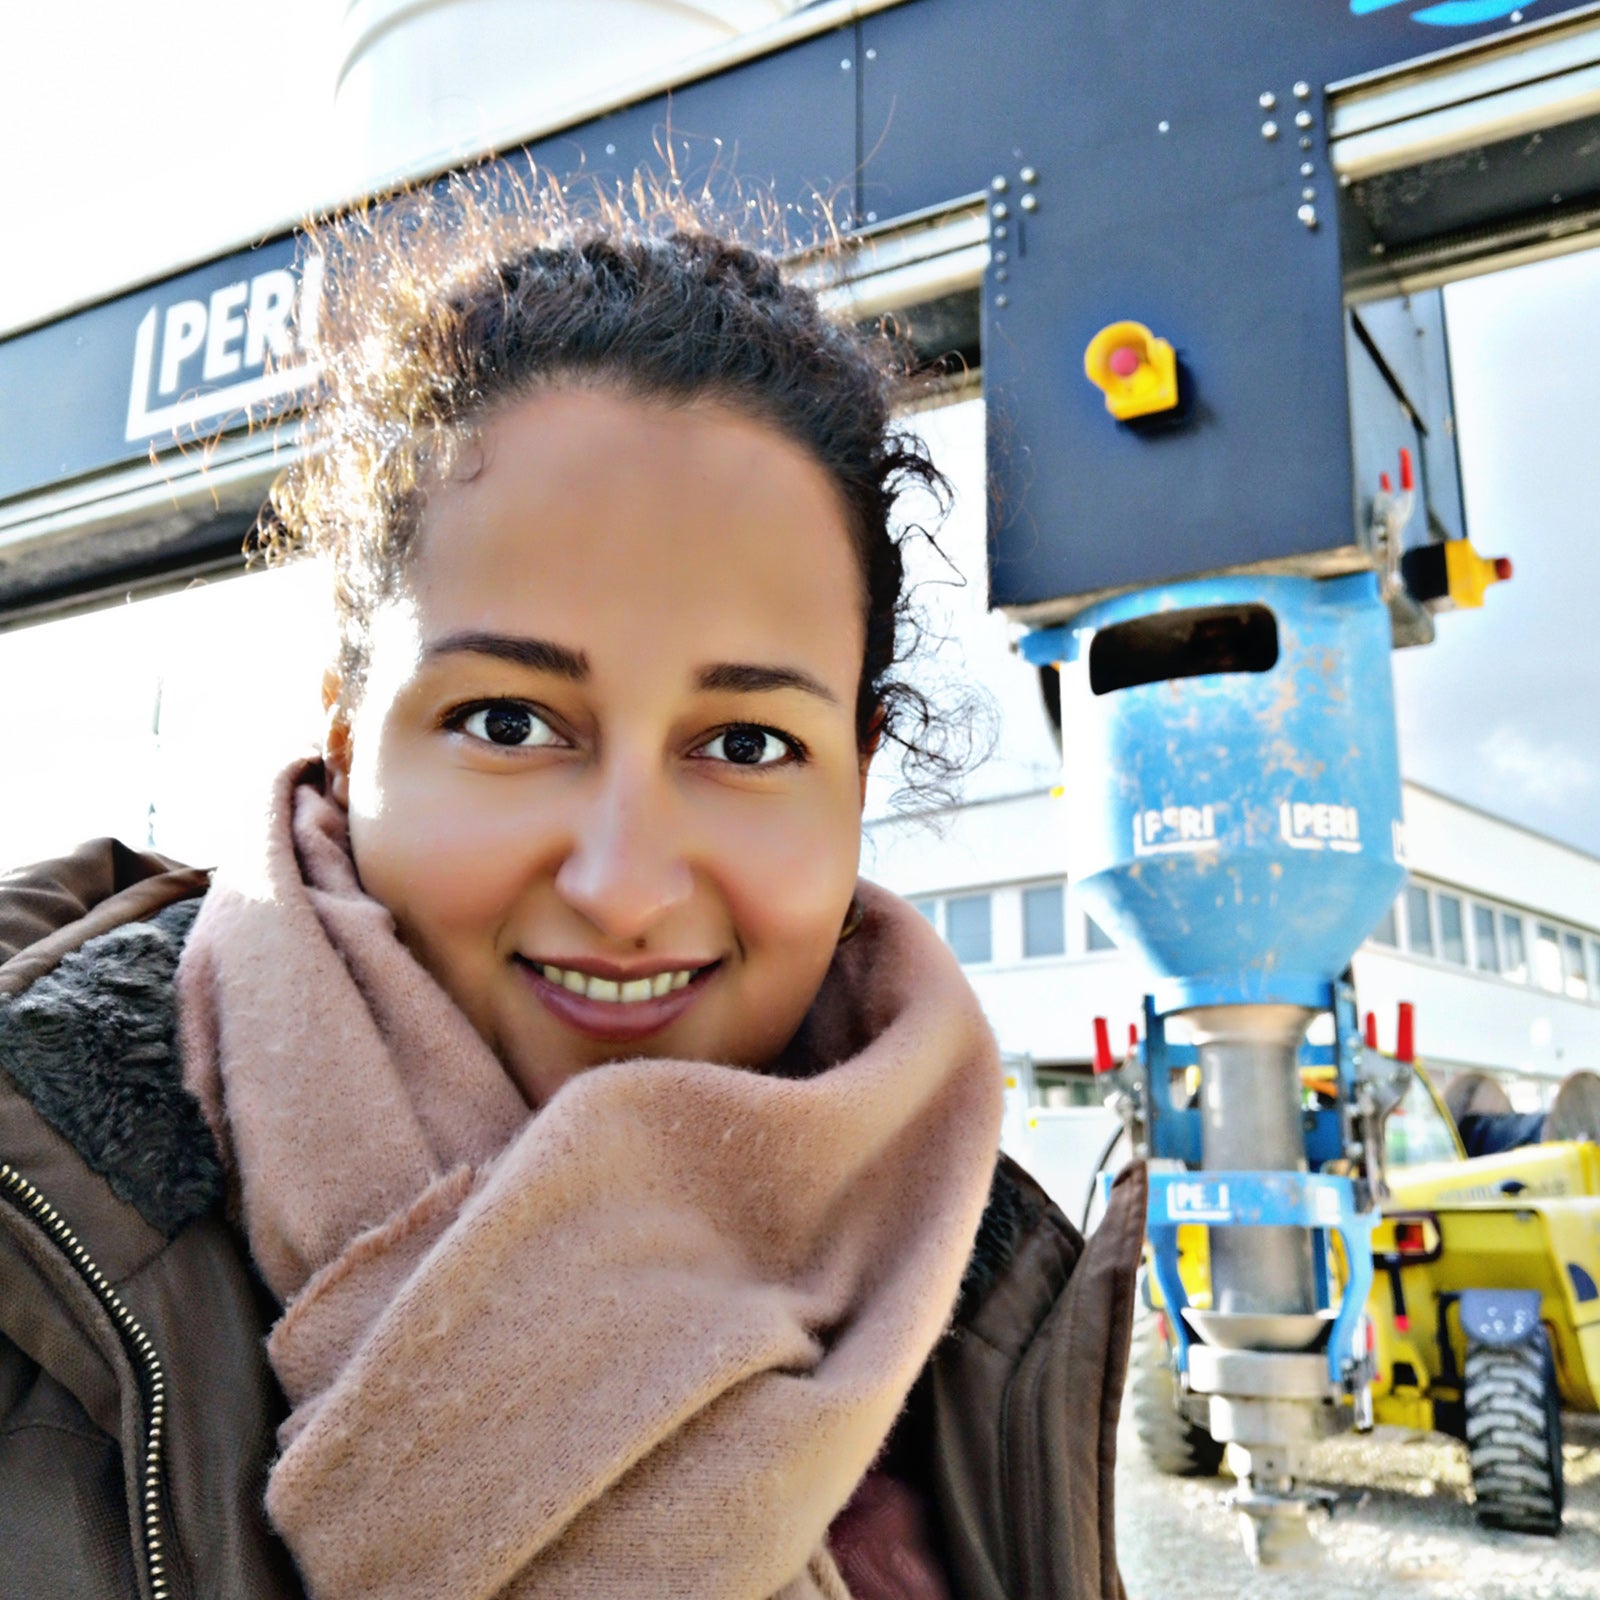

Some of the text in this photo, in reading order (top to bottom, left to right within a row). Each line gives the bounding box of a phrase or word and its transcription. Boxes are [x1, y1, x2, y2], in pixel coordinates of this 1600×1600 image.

[157, 255, 324, 397] PERI
[1293, 802, 1359, 840] PERI
[1177, 1183, 1230, 1210] PEI
